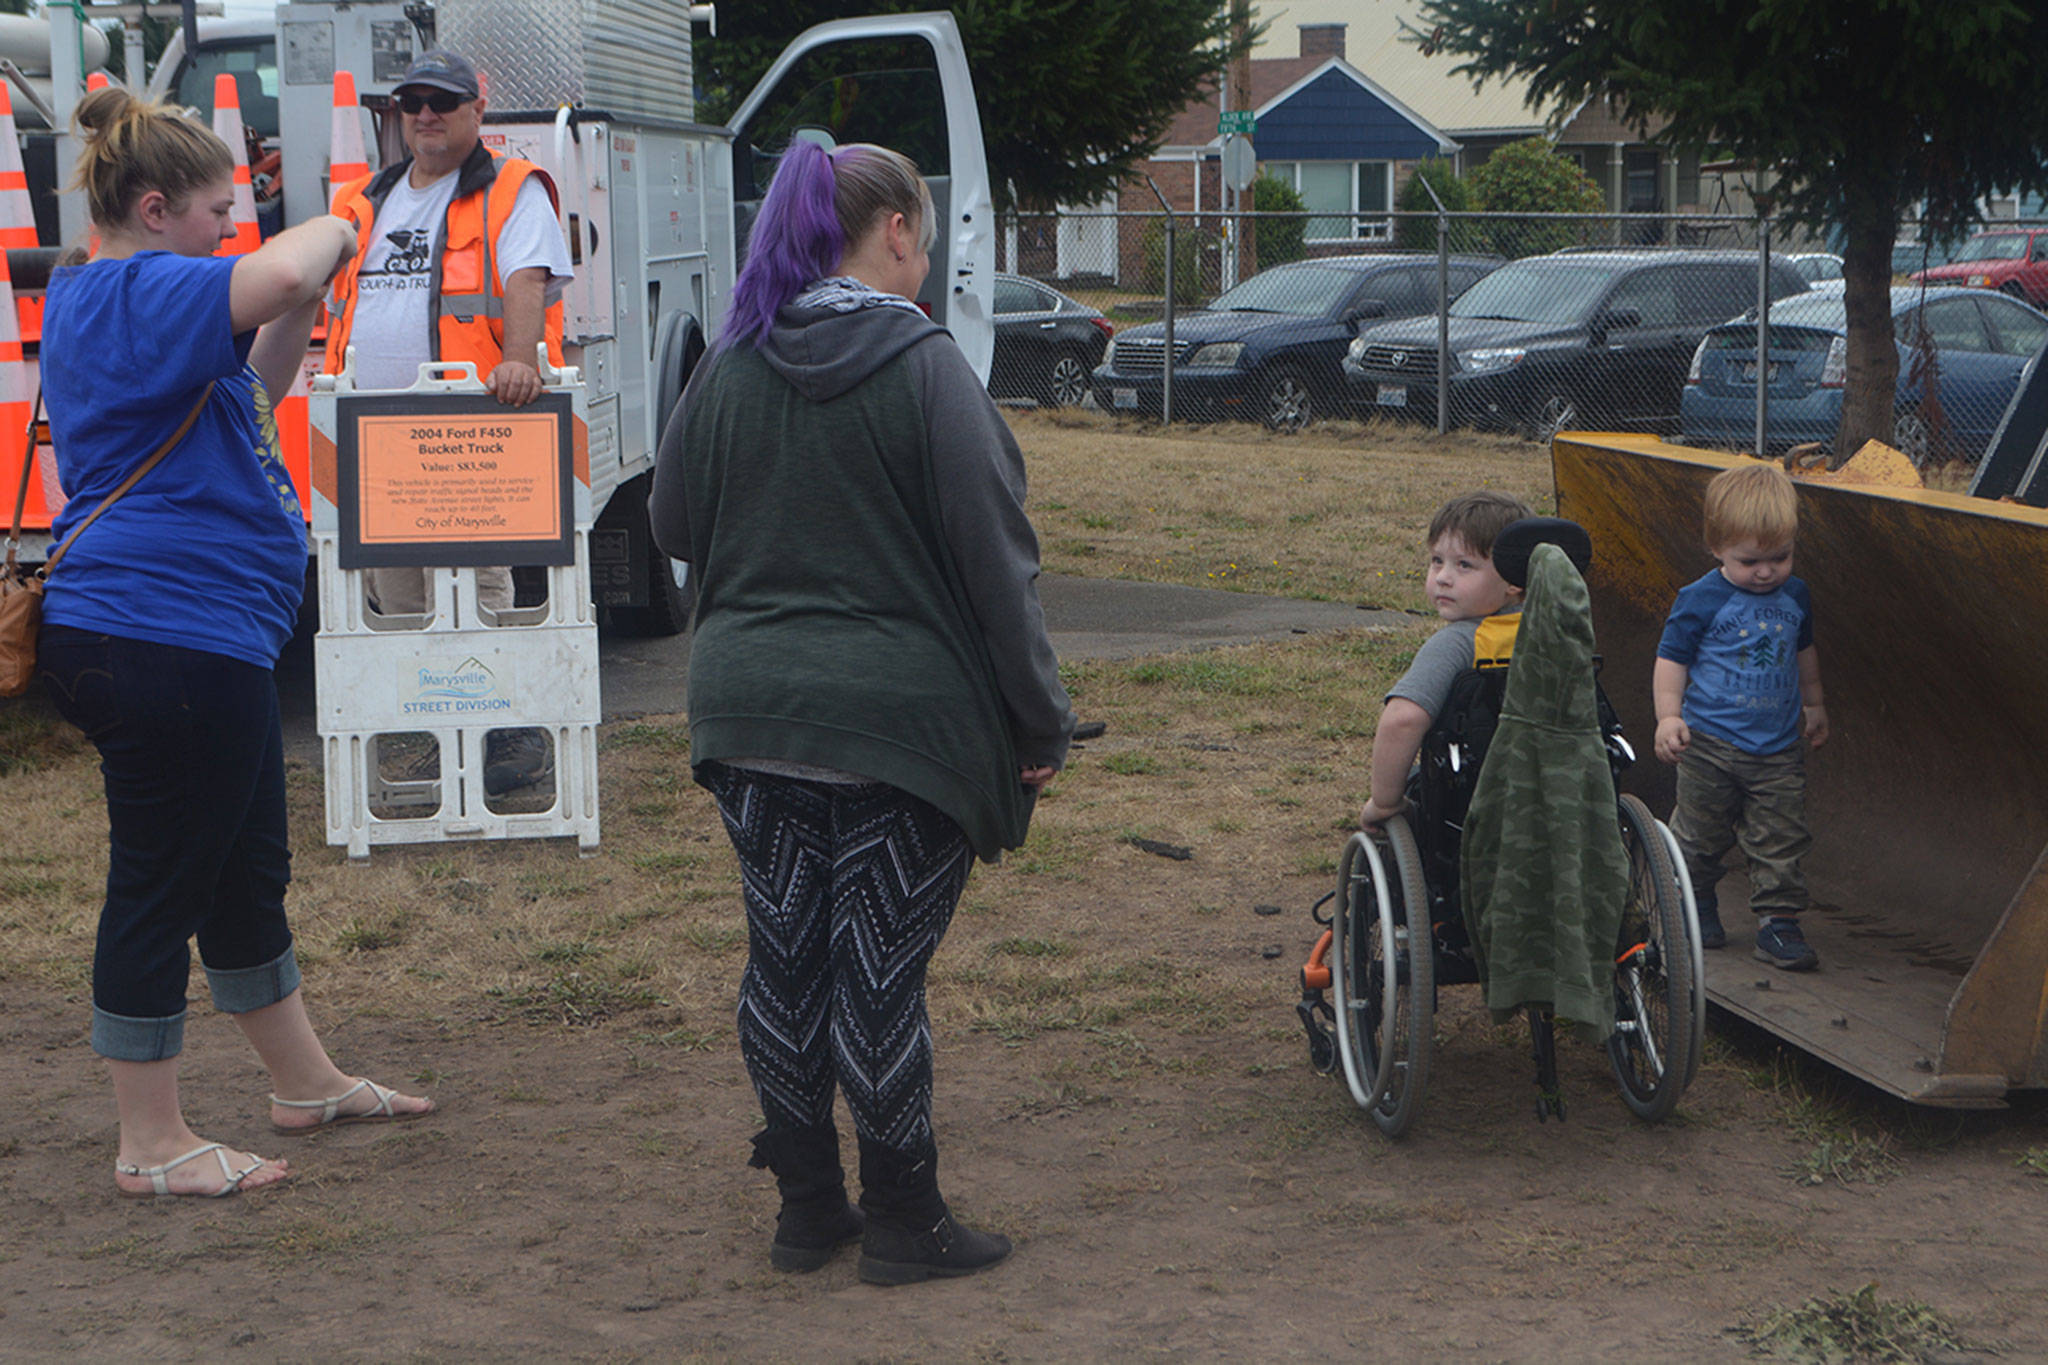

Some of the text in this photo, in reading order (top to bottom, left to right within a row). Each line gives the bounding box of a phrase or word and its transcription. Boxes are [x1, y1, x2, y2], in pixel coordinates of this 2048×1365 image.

[410, 426, 512, 440] 2004 Ford F450
[418, 441, 504, 455] Bucket Truck
[420, 461, 498, 472] Value: $83,500
[415, 514, 507, 530] City of Marysville
[1710, 613, 1748, 641] PINE
[423, 671, 487, 687] Marysville
[403, 698, 511, 713] STREET DIVISION
[1736, 694, 1779, 709] PARK
